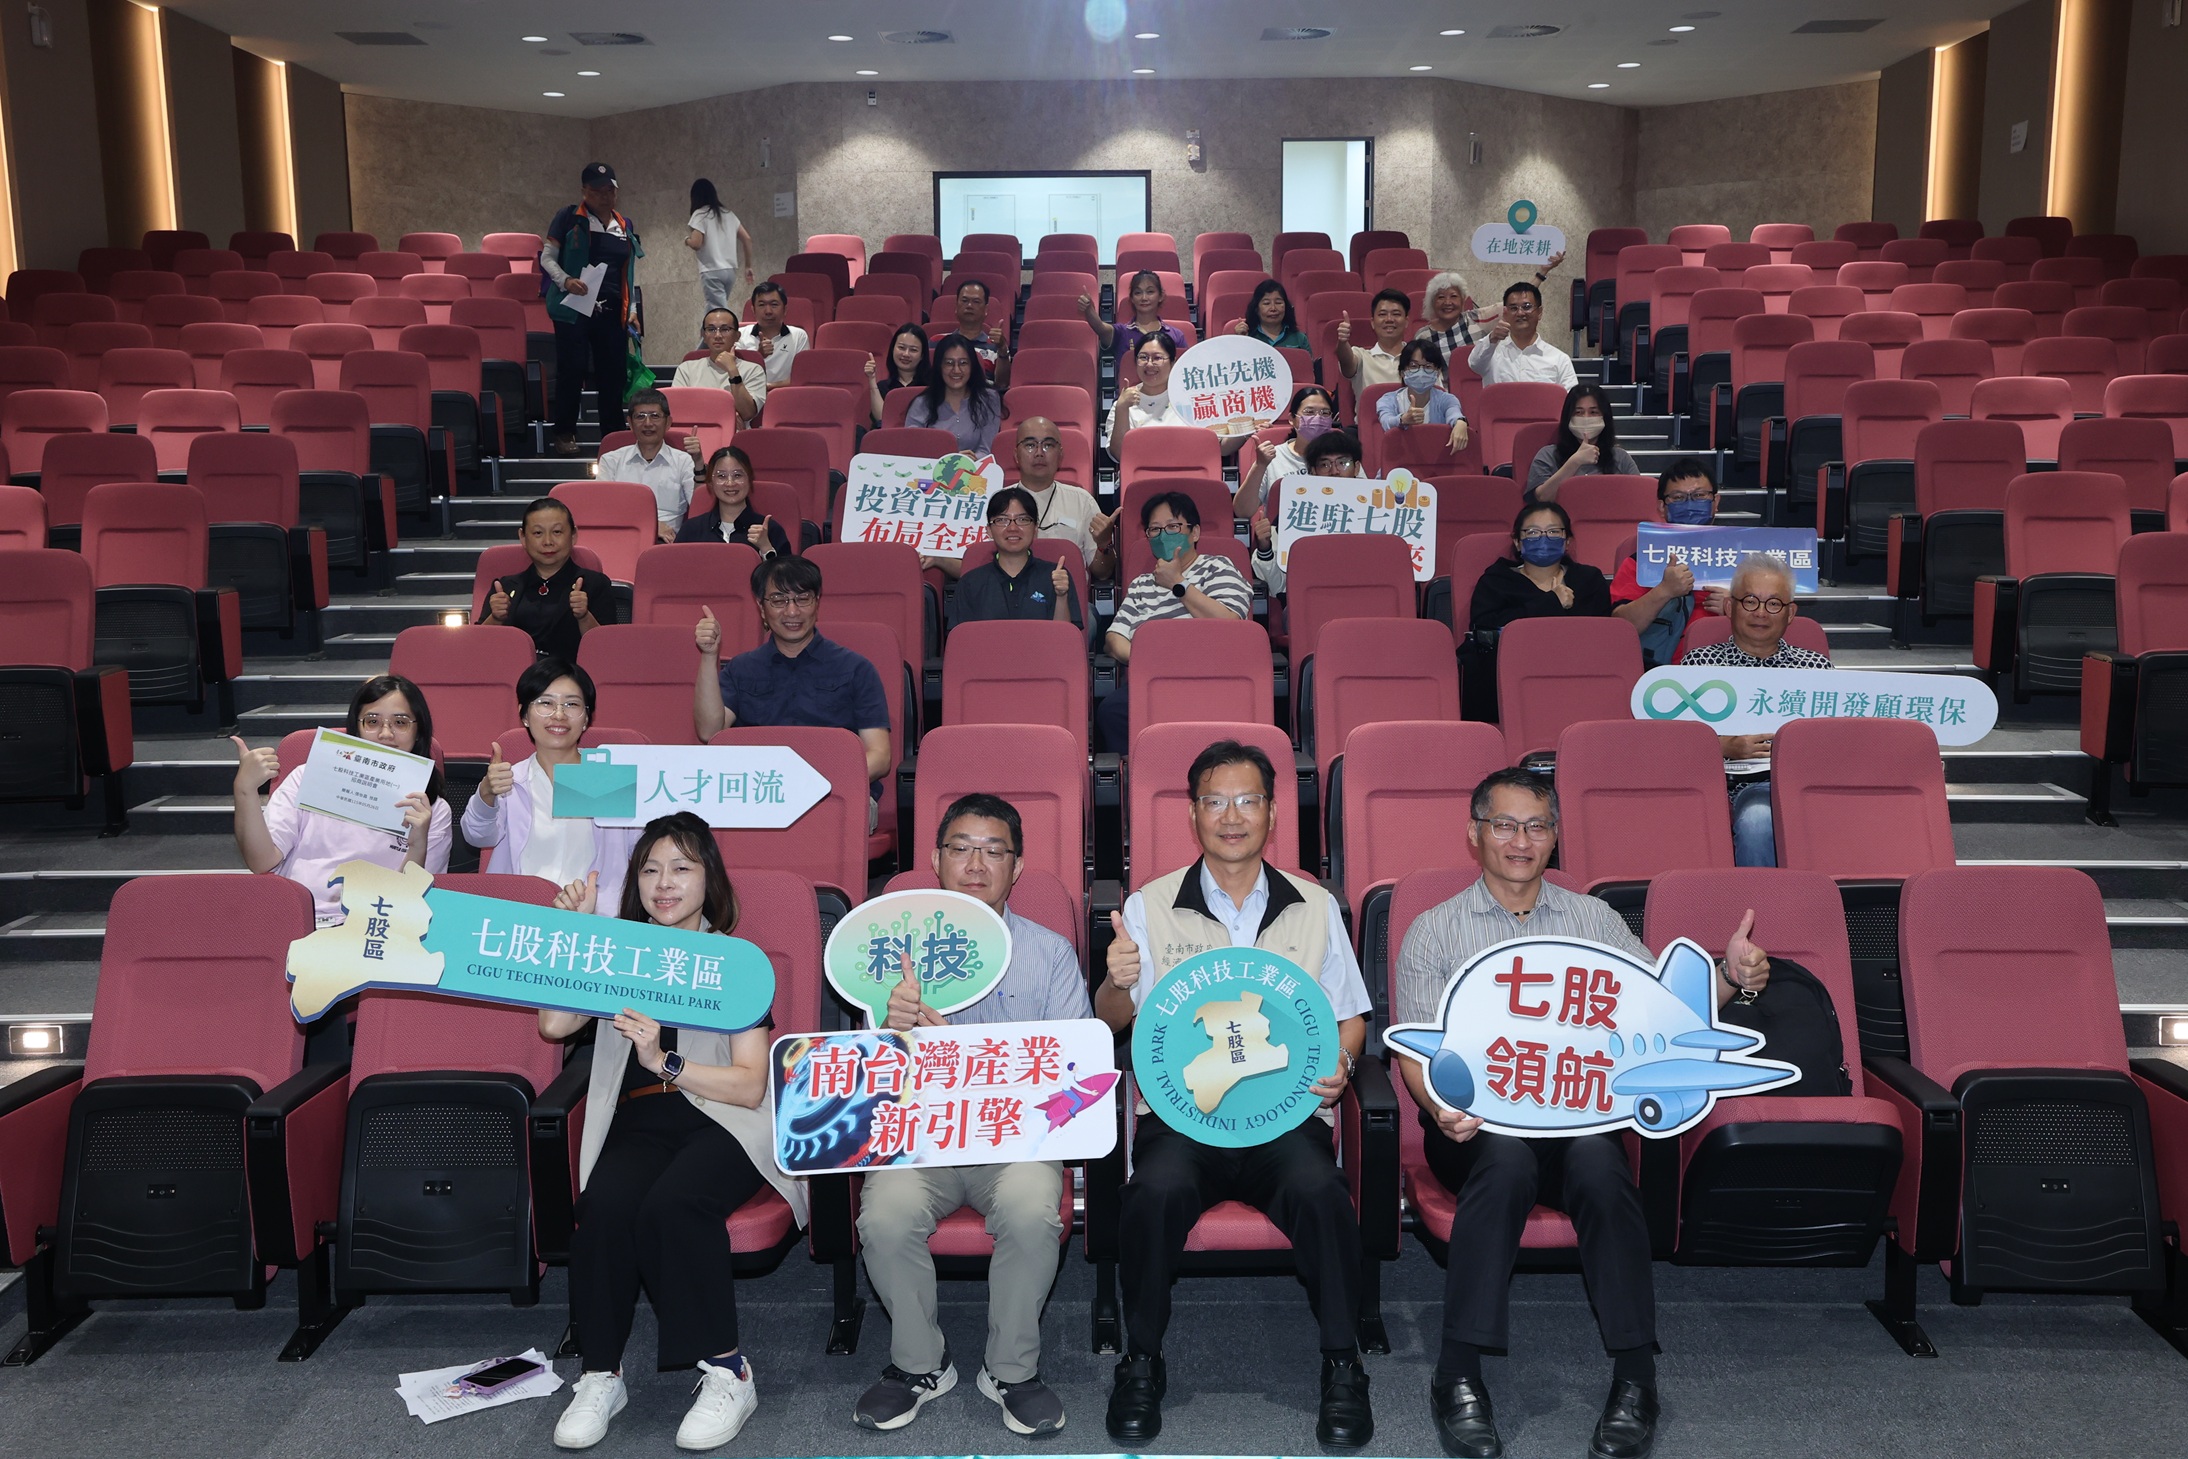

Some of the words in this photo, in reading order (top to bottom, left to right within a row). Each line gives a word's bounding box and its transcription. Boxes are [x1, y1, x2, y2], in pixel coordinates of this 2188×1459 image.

[1486, 238, 1551, 256] 在地深耕
[1183, 356, 1276, 390] 搶佔先機
[1191, 385, 1277, 420] 贏商機
[854, 484, 988, 521] 投資台南
[1284, 500, 1426, 539] 進駐七股
[858, 517, 991, 551] 布局全球
[1746, 688, 1967, 725] 永續開發顧環保
[353, 754, 396, 773] 臺南市政府
[644, 769, 785, 804] 人才回流
[363, 896, 394, 961] 七股區
[472, 918, 725, 991] 七股科技工業區
[867, 932, 969, 982] 科技
[467, 964, 503, 979] CIGU
[506, 969, 602, 994] TECHNOLOGY
[604, 984, 685, 1006] INDUSTRIAL
[688, 996, 722, 1011] PARK
[1155, 959, 1301, 1017] 七股科技工業區
[1494, 956, 1622, 1031] 七股
[1294, 998, 1320, 1037] CIGU
[1151, 1023, 1168, 1065] PARK
[1226, 1021, 1246, 1064] 七股區
[811, 1035, 1062, 1097] 南台灣產業
[1245, 1045, 1320, 1130] TECHNOLOGY
[1486, 1036, 1615, 1113] 領航
[1156, 1071, 1236, 1131] INDUSTRIAL
[871, 1098, 1023, 1152] 新引擎
